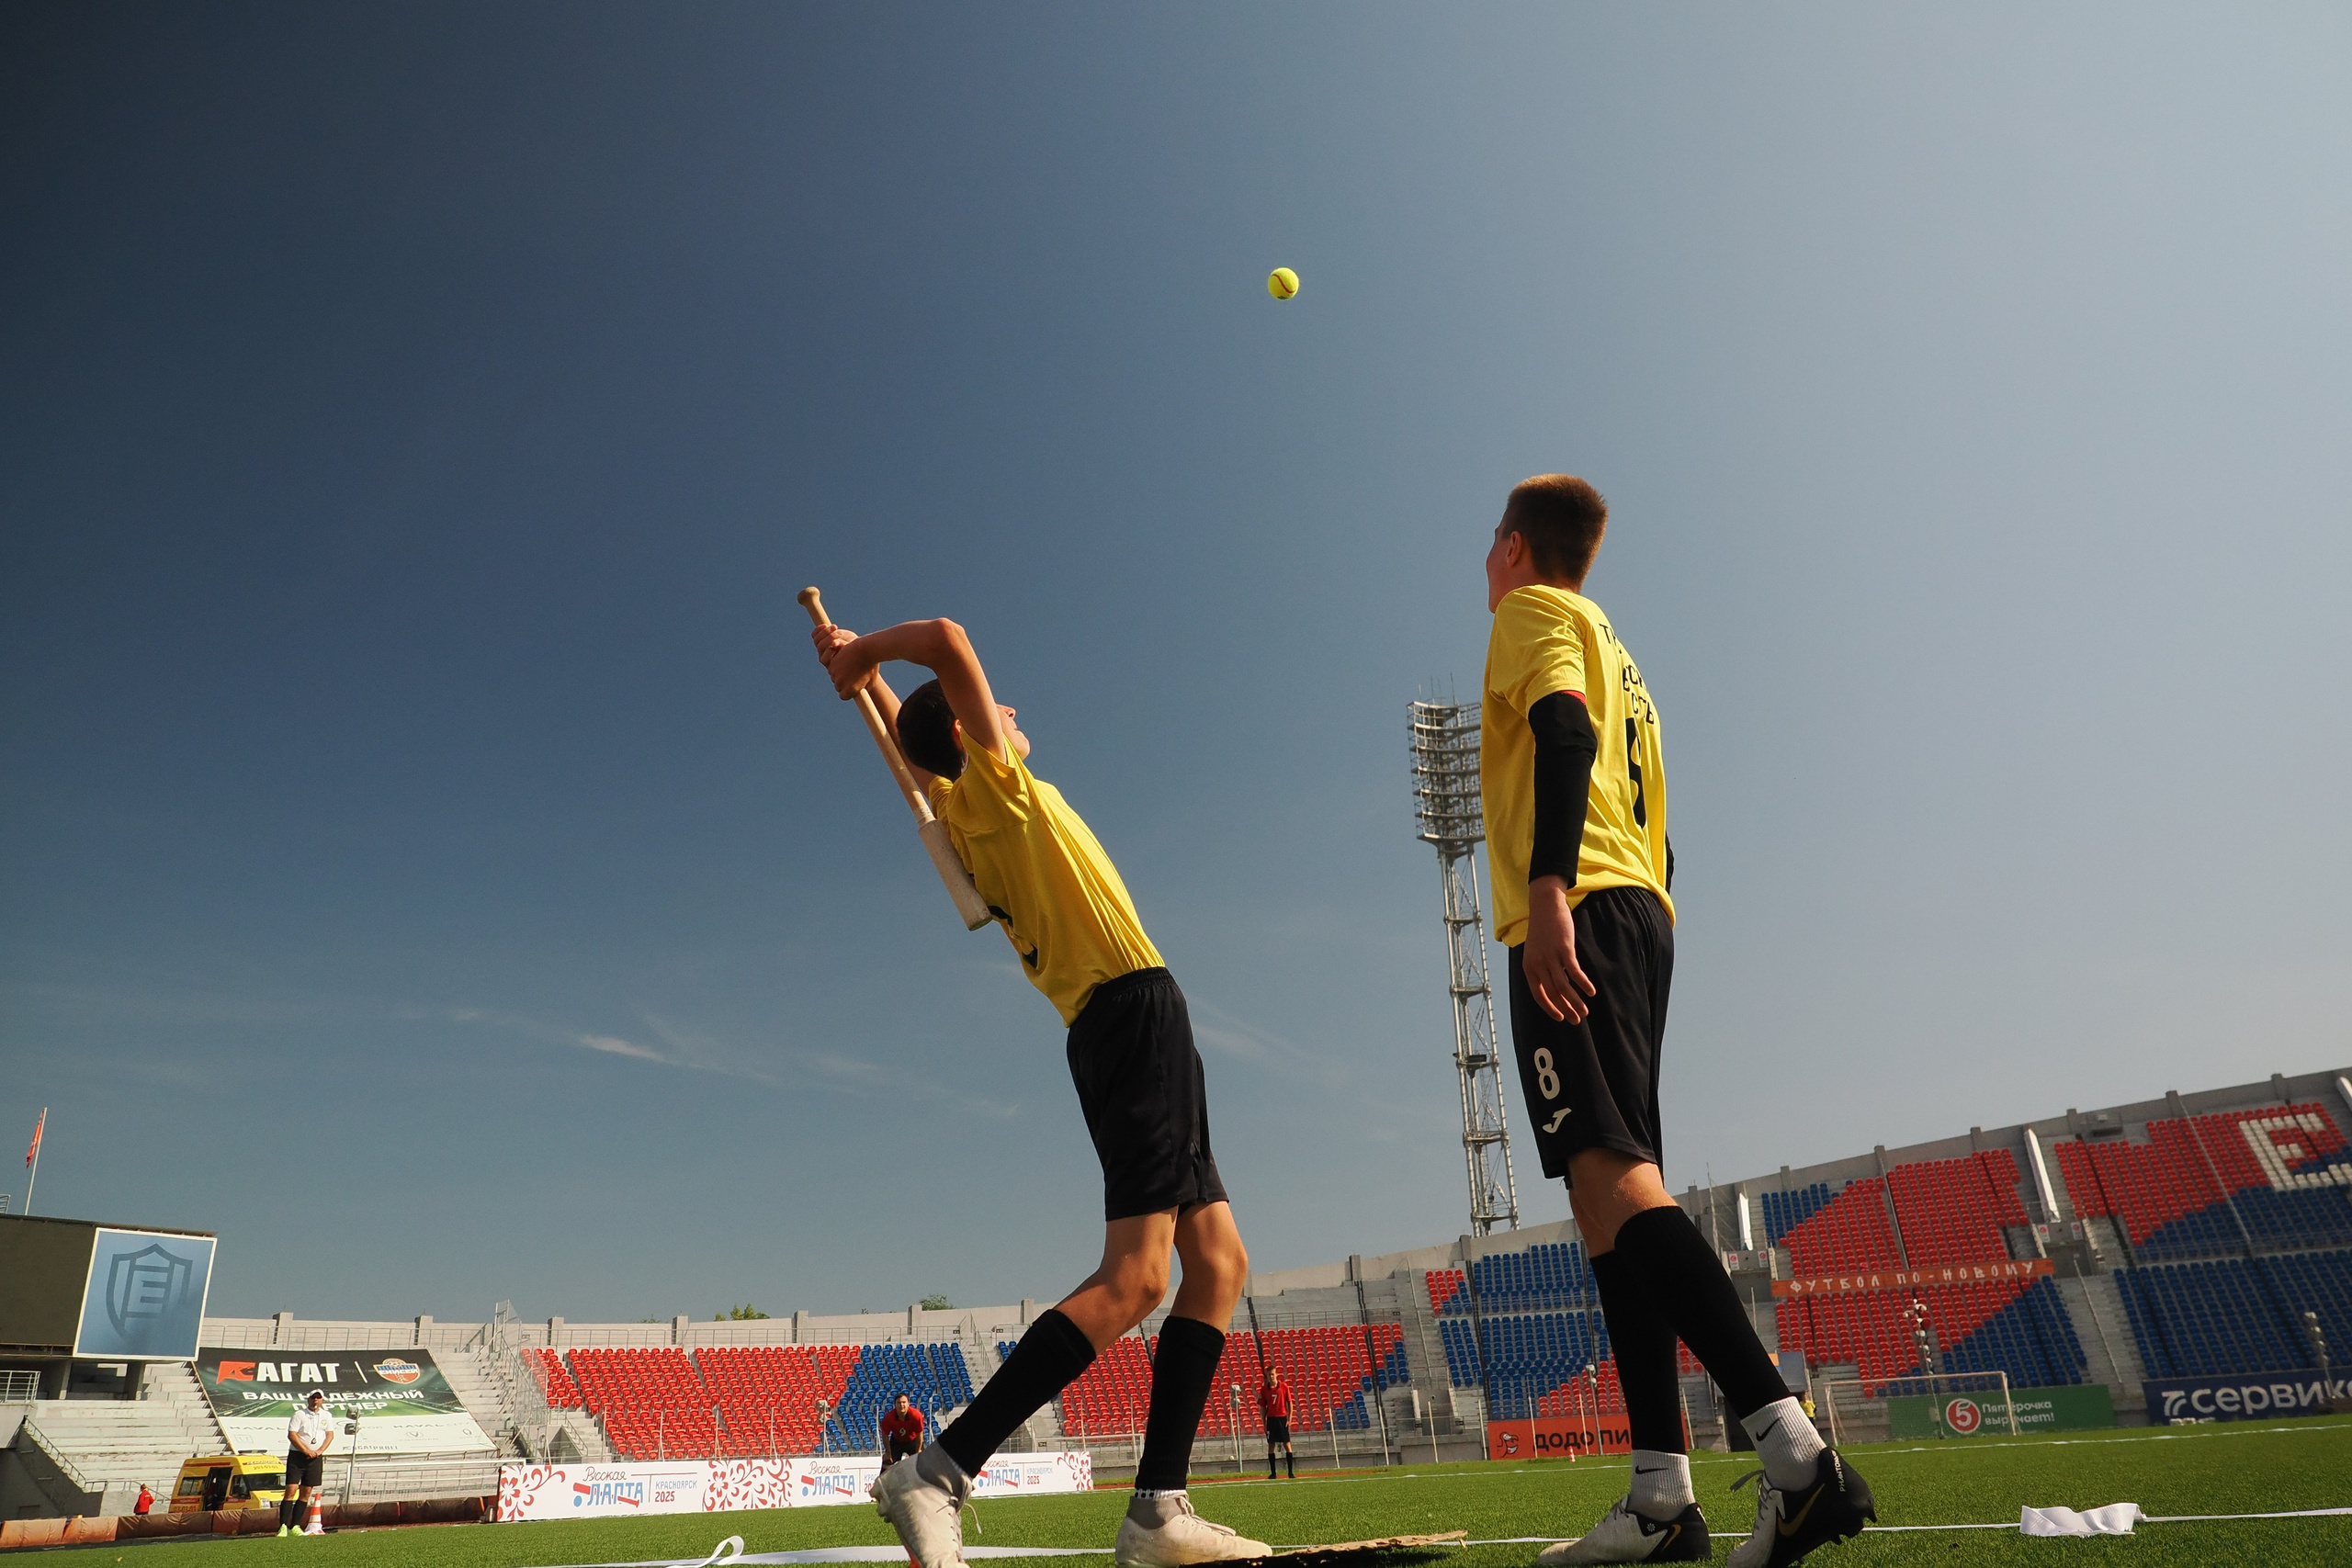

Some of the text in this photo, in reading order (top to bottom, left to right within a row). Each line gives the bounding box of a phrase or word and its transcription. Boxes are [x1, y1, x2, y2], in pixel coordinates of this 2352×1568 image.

[1533, 1047, 1561, 1100] 8
[1790, 1274, 1881, 1292] ФУТБОЛ
[256, 1361, 340, 1382] АГАТ
[242, 1392, 293, 1401] ВАШ
[1271, 1393, 1278, 1404] 7
[292, 1402, 388, 1411] ПРТНЕР
[1984, 1412, 2055, 1427] вырчает!
[899, 1427, 907, 1437] 9
[1532, 1429, 1631, 1451] ДОДО ПИ
[808, 1461, 841, 1474] Русская
[986, 1460, 1010, 1468] усская
[582, 1466, 627, 1481] Русская
[987, 1469, 1020, 1486] ЛАПТА
[1026, 1475, 1040, 1484] 2025
[655, 1479, 697, 1490] КРАСНОЯРСК
[812, 1474, 854, 1495] ЛАПТА
[587, 1482, 643, 1506] ЛАПТА
[655, 1491, 675, 1502] 2025
